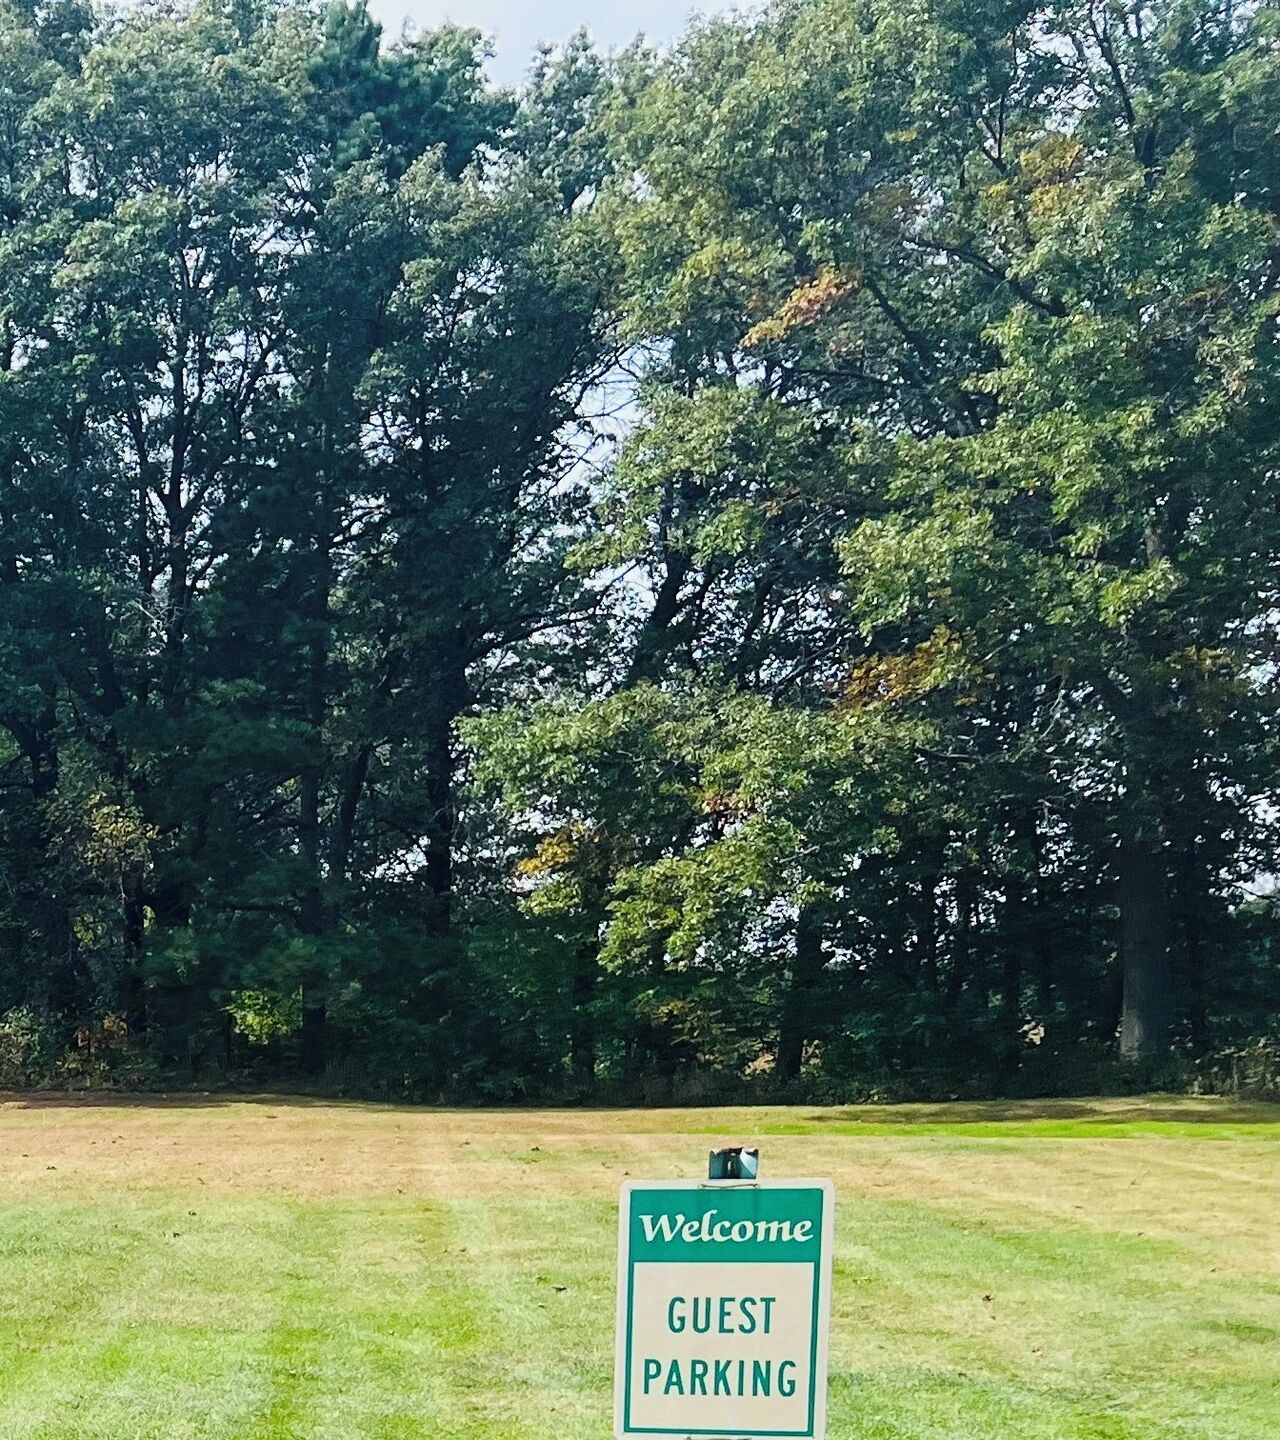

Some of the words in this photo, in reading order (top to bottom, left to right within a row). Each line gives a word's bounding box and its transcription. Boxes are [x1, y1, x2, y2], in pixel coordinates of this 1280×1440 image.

[639, 1209, 813, 1242] Welcome
[668, 1297, 776, 1334] GUEST
[643, 1359, 797, 1397] PARKING
